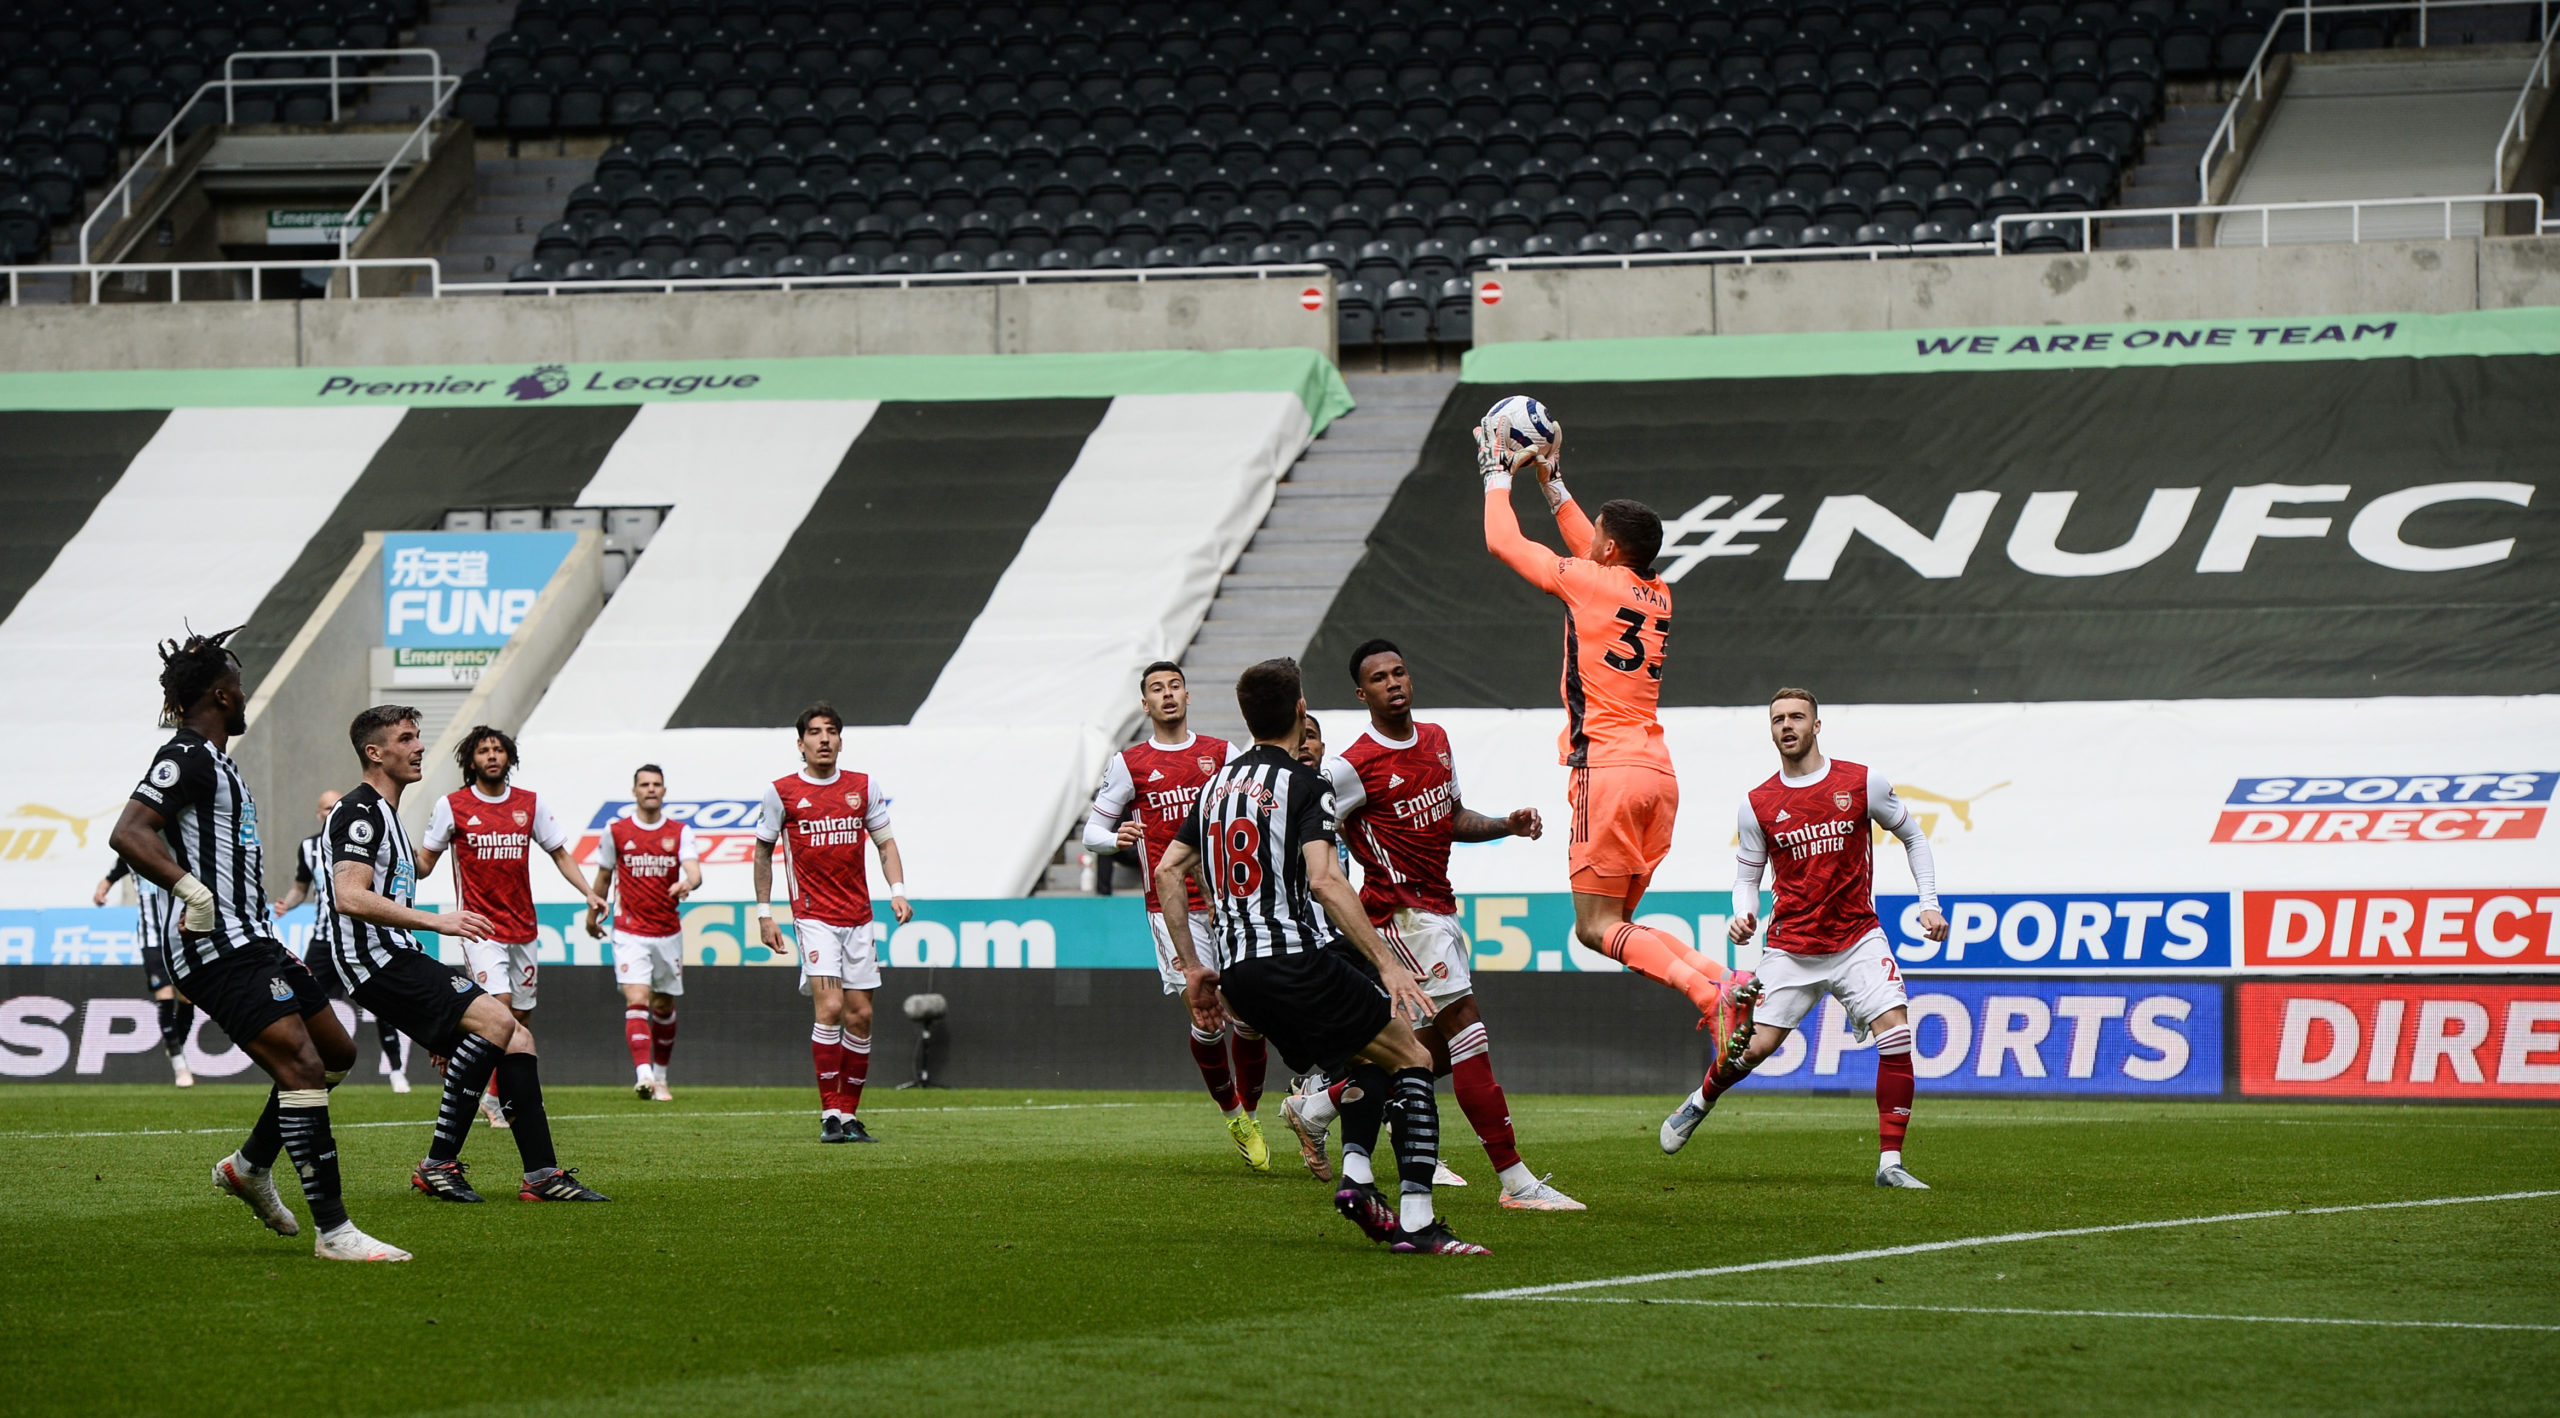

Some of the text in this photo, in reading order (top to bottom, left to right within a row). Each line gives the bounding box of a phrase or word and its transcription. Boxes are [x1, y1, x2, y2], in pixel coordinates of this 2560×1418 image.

[1915, 321, 2398, 356] WE ARE ONE TEAM
[317, 370, 760, 398] Premier League
[1661, 481, 2536, 583] #NUFC
[389, 546, 489, 588] 乐天堂
[388, 588, 542, 636] FUN8
[1632, 585, 1667, 611] RYAN
[399, 647, 495, 668] Emergency
[1147, 784, 1202, 809] Emira
[1203, 777, 1279, 820] FERNANDEZ
[2246, 773, 2541, 803] SPORTS
[798, 815, 864, 835] Emirates
[1162, 805, 1180, 822] FLY
[1413, 811, 1429, 830] FLY
[2231, 809, 2526, 842] DIRECT
[466, 831, 528, 847] Emirates
[811, 831, 858, 847] FLY BETTER
[1774, 818, 1855, 848] Emirates
[477, 846, 523, 860] FLY BETTER
[1208, 817, 1263, 901] 18
[1791, 836, 1844, 861] FLY BETTER
[1895, 897, 2210, 963] SPORTS
